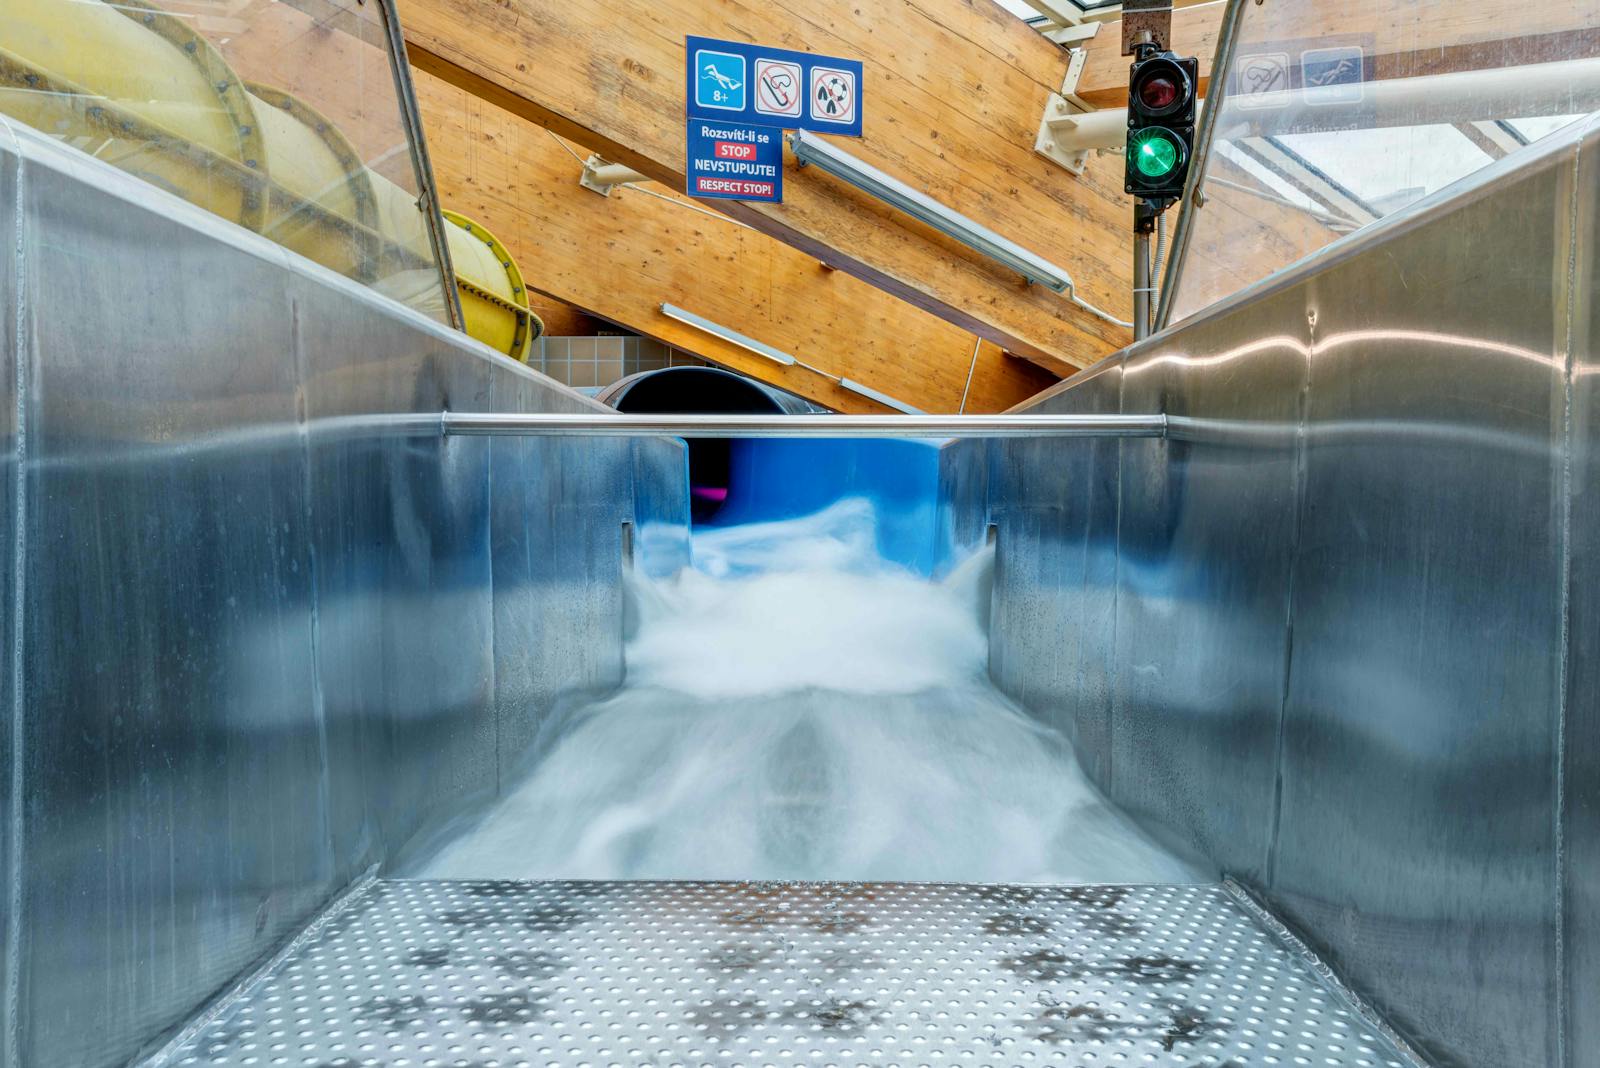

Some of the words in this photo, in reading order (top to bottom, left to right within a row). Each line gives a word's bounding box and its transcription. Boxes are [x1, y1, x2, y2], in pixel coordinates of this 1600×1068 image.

[713, 90, 728, 103] 8+
[701, 126, 756, 142] Rozsvítí-li
[757, 134, 769, 143] se
[721, 145, 750, 157] STOP
[694, 158, 776, 177] NEVSTUPUJTE!
[700, 179, 742, 192] RESPECT
[743, 183, 771, 195] STOP!
